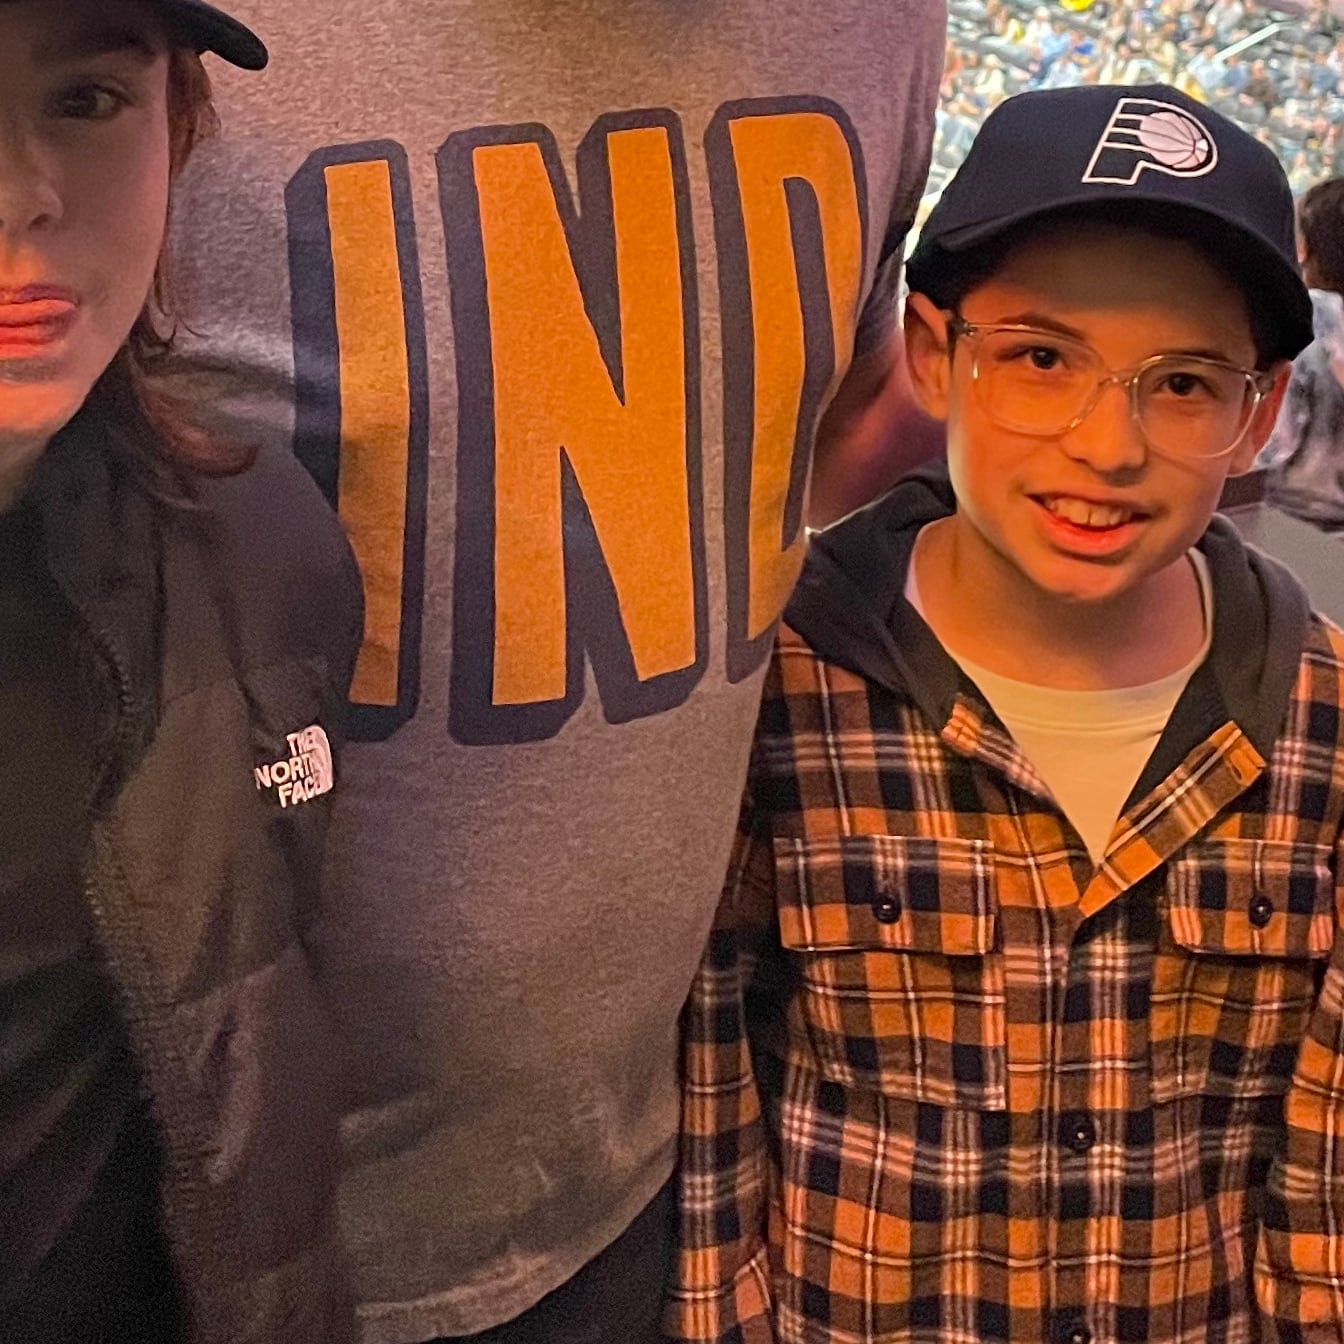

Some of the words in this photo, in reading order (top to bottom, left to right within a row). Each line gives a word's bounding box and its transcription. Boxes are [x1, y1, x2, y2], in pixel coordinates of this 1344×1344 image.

[286, 730, 318, 756] THE
[254, 753, 320, 790] NORTH
[278, 775, 324, 808] FACE
